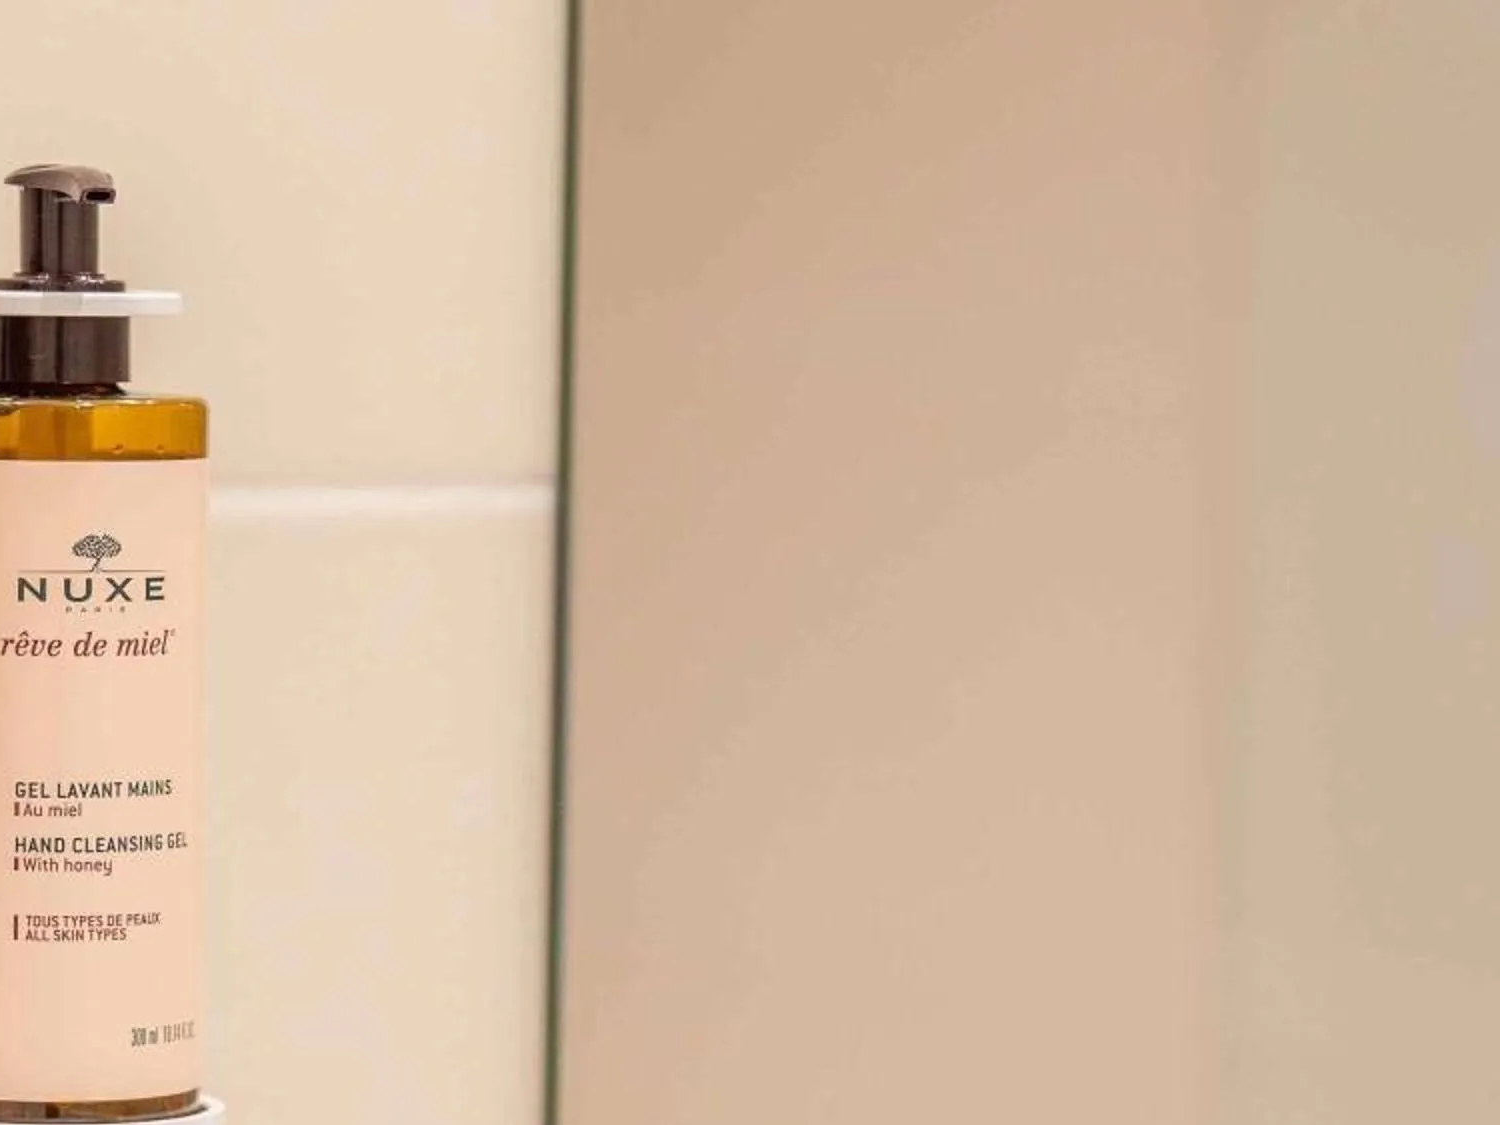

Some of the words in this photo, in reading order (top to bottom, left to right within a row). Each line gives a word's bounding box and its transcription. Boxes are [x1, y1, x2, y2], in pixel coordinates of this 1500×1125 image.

[17, 577, 166, 602] NUXE
[0, 631, 62, 657] rêve
[73, 632, 107, 657] de
[15, 781, 49, 798] GEL
[57, 781, 122, 798] LAVANT
[128, 779, 173, 797] MAINS
[23, 803, 43, 816] Au
[48, 802, 83, 817] miel
[15, 836, 65, 853] HAND
[71, 833, 163, 853] CLEANSING
[167, 832, 188, 848] GEL
[23, 858, 59, 872] With
[63, 858, 113, 876] honey
[26, 915, 59, 928] TOUS
[63, 915, 103, 927] TYPES
[107, 914, 122, 927] DE
[126, 912, 160, 925] PEAUX
[26, 929, 49, 942] ALL
[53, 929, 85, 942] SKIN
[89, 927, 126, 941] TYPES
